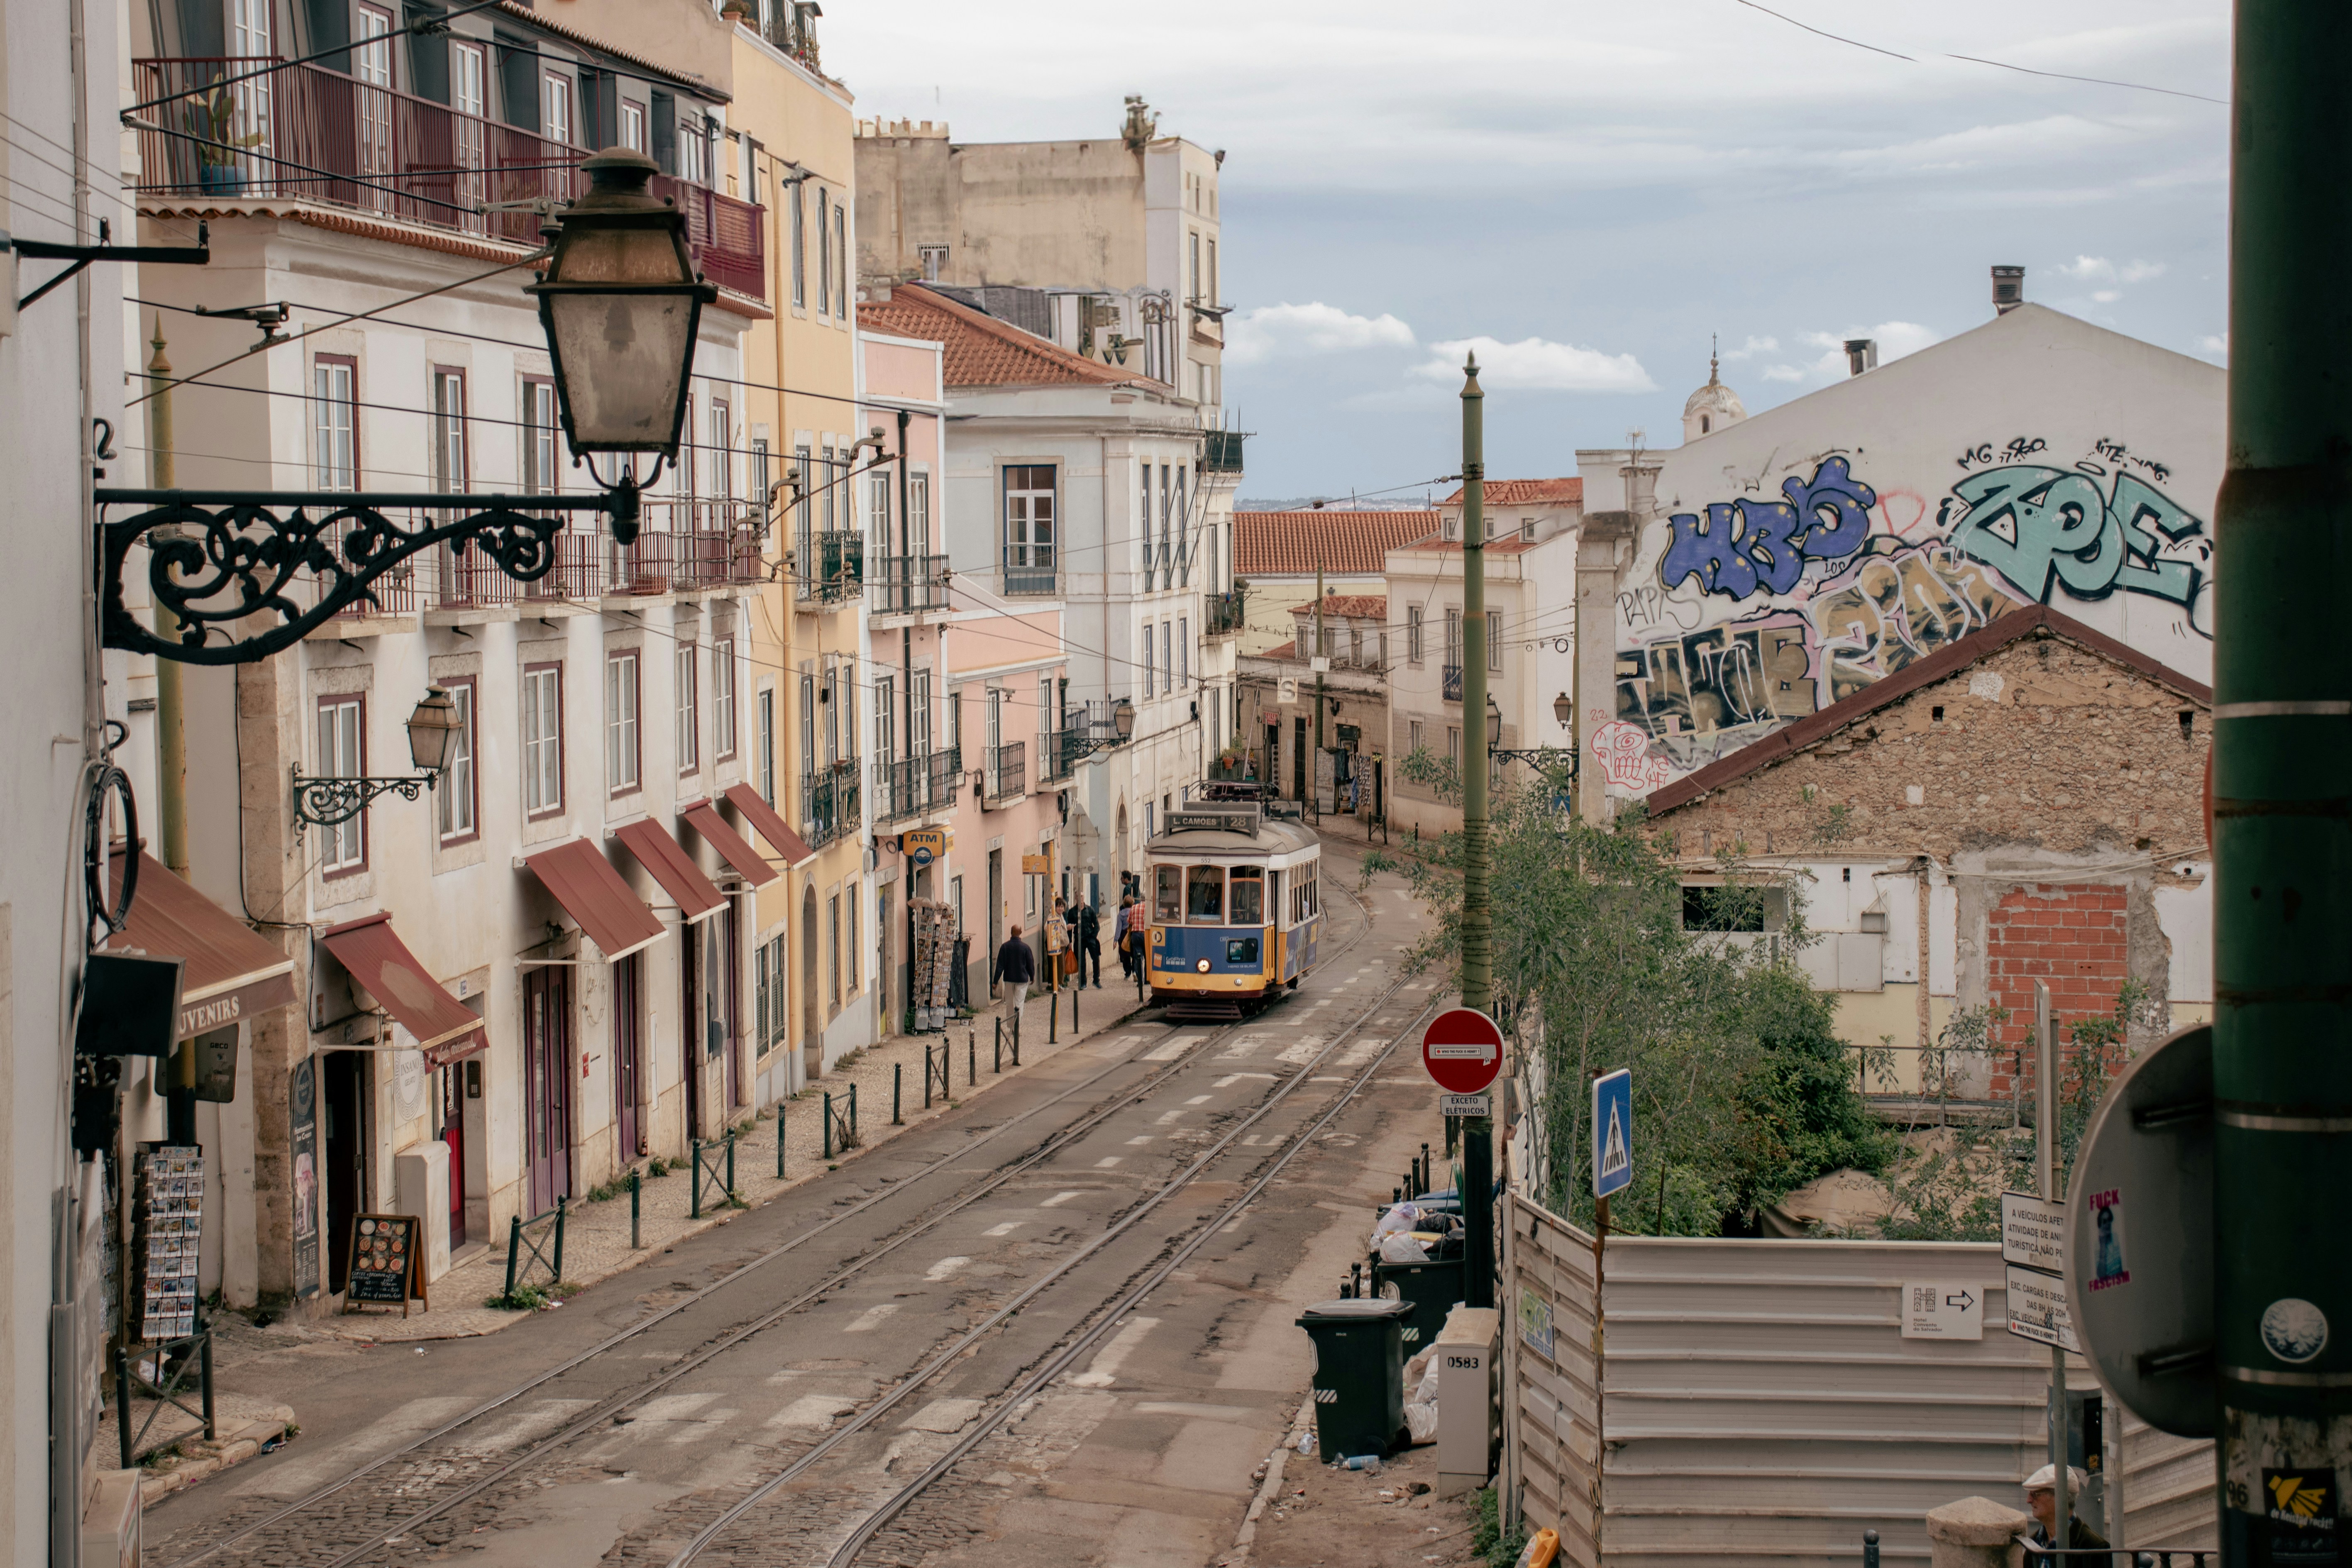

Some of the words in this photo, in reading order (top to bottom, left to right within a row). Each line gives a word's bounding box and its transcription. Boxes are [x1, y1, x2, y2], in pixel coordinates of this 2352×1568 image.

[1173, 817, 1180, 825] L.
[1230, 817, 1246, 828] 28
[910, 834, 937, 843] ATM
[401, 1058, 420, 1077] INSANO
[405, 1076, 416, 1086] GELATO
[1446, 1105, 1485, 1114] ELÉTRICOS
[2089, 1189, 2120, 1211] FUCK
[2012, 1209, 2016, 1218] A
[2017, 1209, 2047, 1223] VEÍCULOS
[2008, 1224, 2039, 1237] ATIVIDADE
[2041, 1230, 2049, 1239] DE
[2050, 1231, 2063, 1242] ANI
[2040, 1244, 2054, 1256] NÃO
[2088, 1270, 2131, 1293] FASCISM
[2010, 1281, 2022, 1292] EXC.
[2022, 1284, 2044, 1297] CARGAS
[2045, 1290, 2049, 1299] E
[2026, 1300, 2037, 1310] DAS
[2038, 1304, 2046, 1312] 8H
[2055, 1308, 2066, 1318] 20H
[2031, 1328, 2039, 1336] FUCK
[2043, 1331, 2054, 1340] HENRY
[1447, 1356, 1479, 1369] 0583
